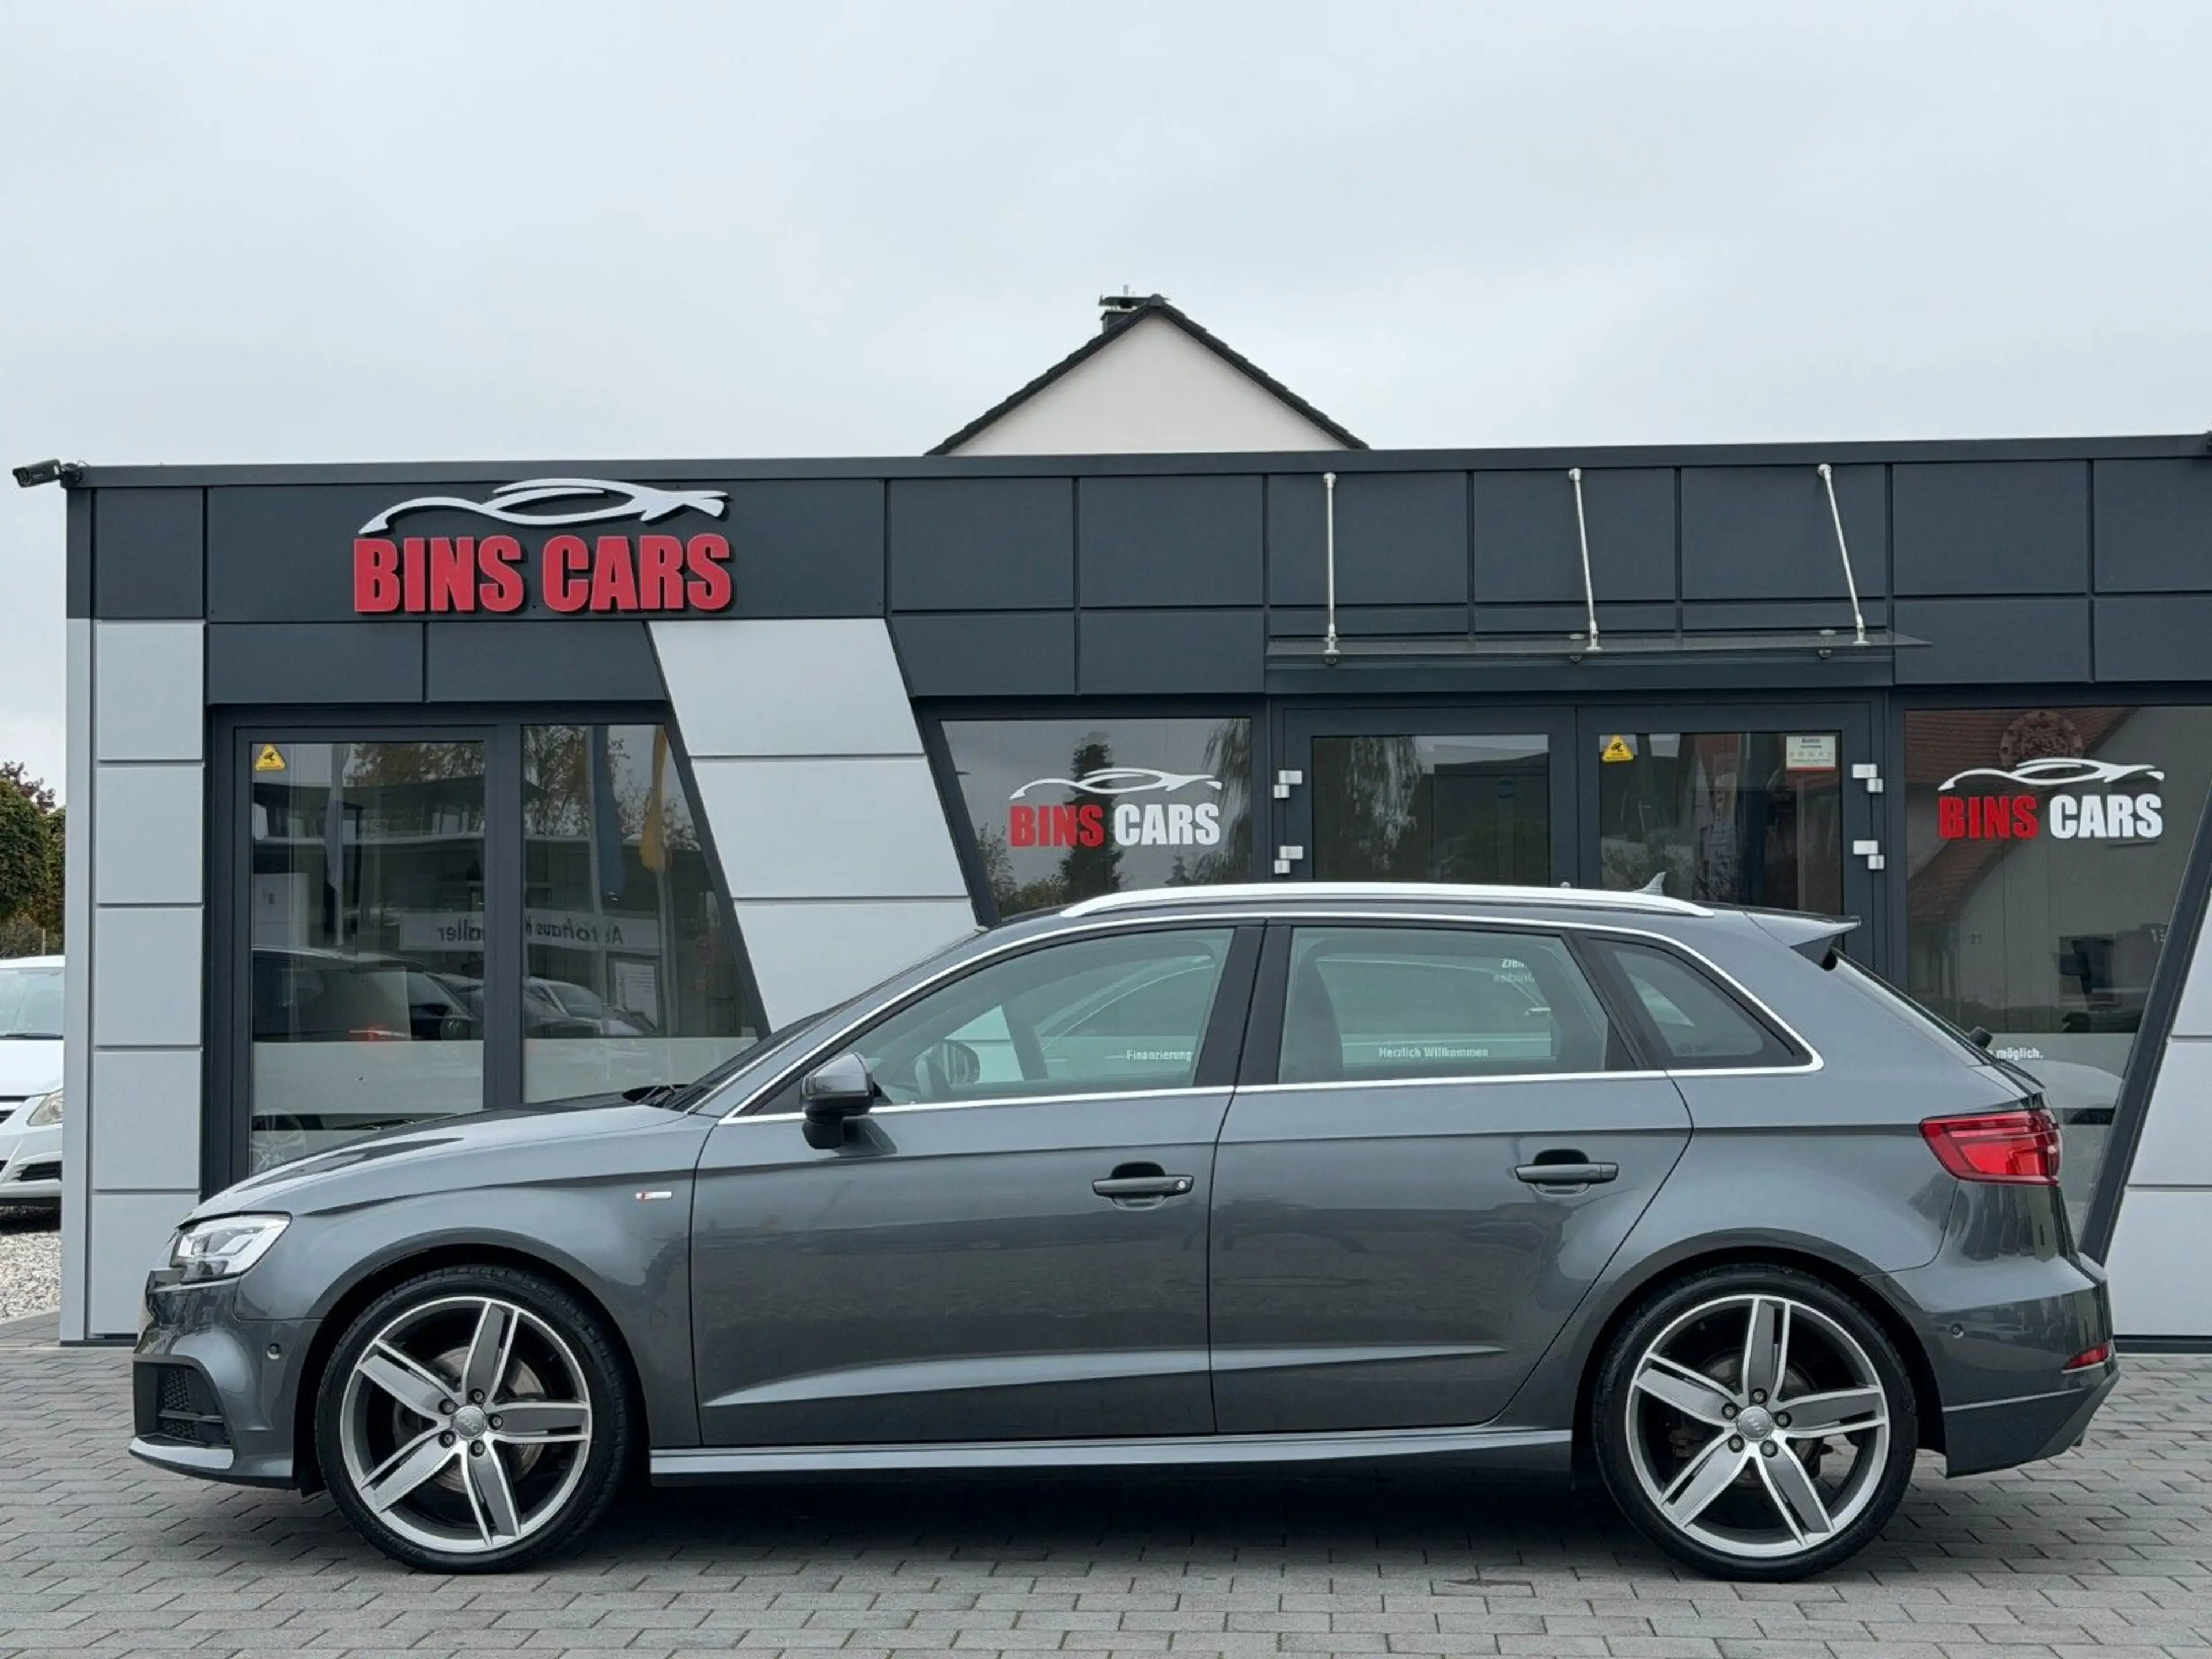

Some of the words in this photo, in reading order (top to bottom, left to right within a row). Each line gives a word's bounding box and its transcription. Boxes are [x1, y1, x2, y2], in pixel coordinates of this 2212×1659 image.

[354, 535, 524, 612] BINS
[543, 533, 732, 612] CARS
[1010, 804, 1104, 847] BINS
[1113, 802, 1221, 846] CARS
[1938, 794, 2040, 840] BINS
[2049, 793, 2163, 839] CARS
[1126, 1050, 1192, 1062] Finanzierung
[1379, 1046, 1421, 1059] Herzlich
[1424, 1046, 1489, 1058] Willkommen
